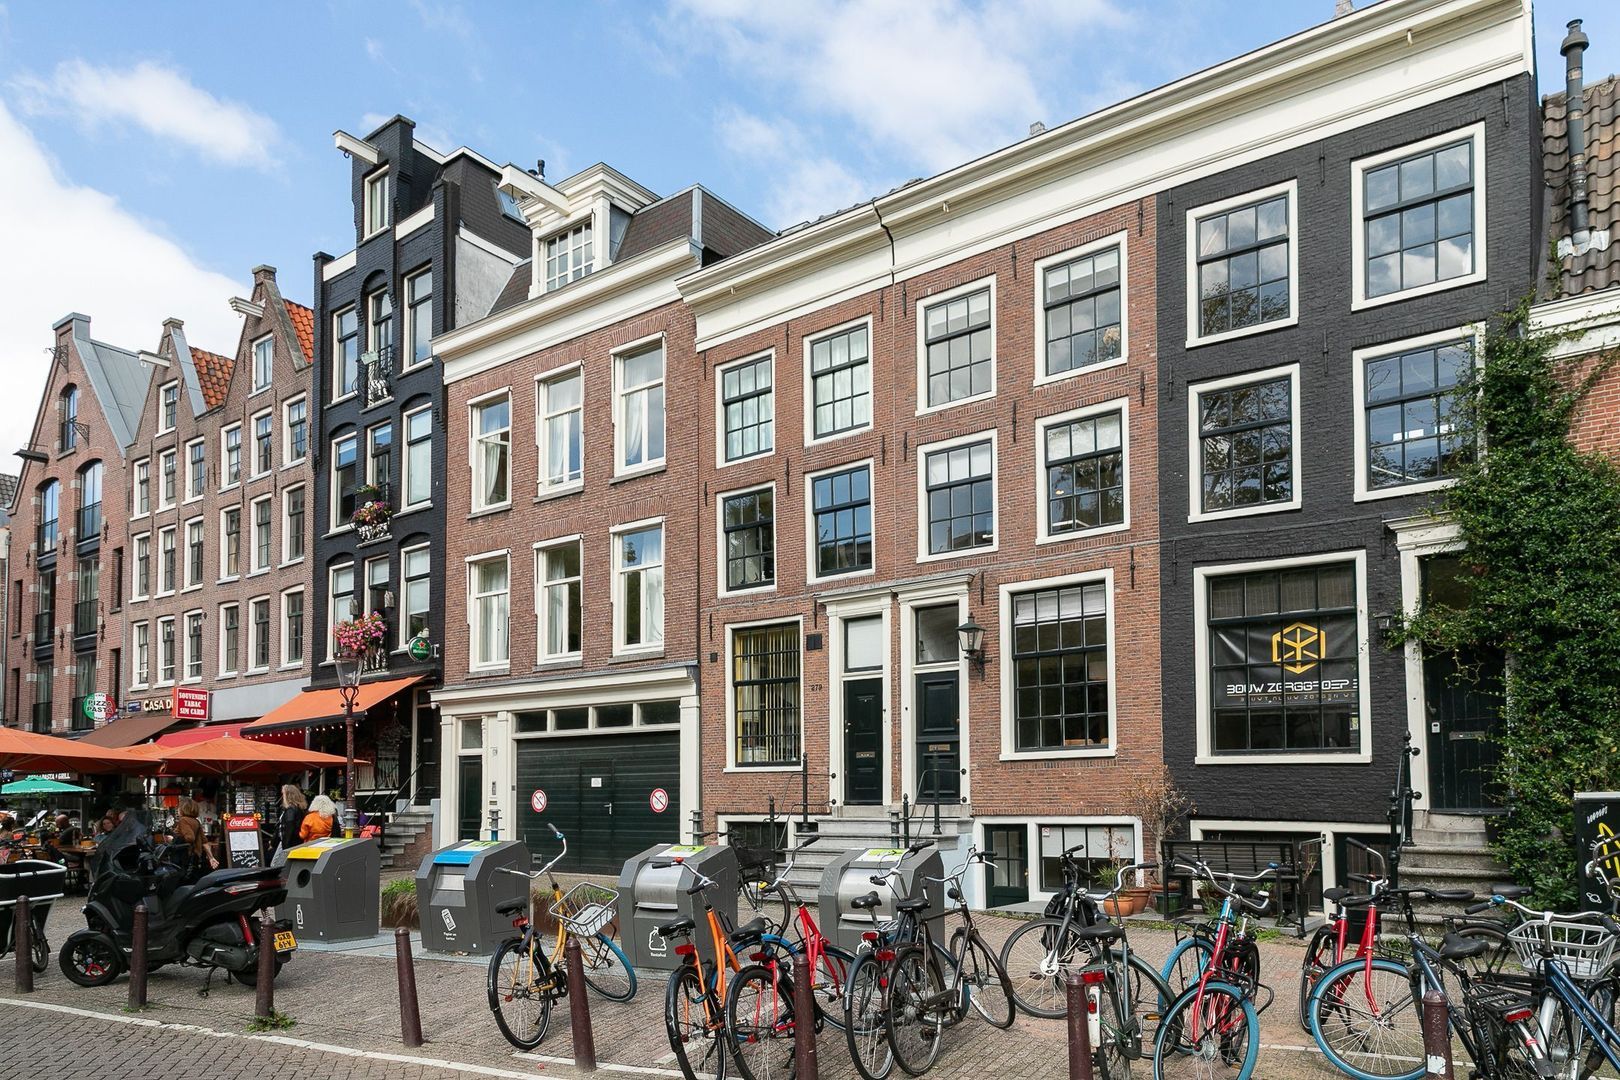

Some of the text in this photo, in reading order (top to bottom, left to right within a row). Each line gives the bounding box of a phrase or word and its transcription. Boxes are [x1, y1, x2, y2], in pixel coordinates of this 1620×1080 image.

[1227, 683, 1265, 694] BOUW
[179, 692, 207, 700] SOUVENIRS
[143, 700, 165, 711] CASA
[184, 700, 202, 708] TABAC
[179, 707, 190, 715] SIM
[278, 932, 291, 940] GXB
